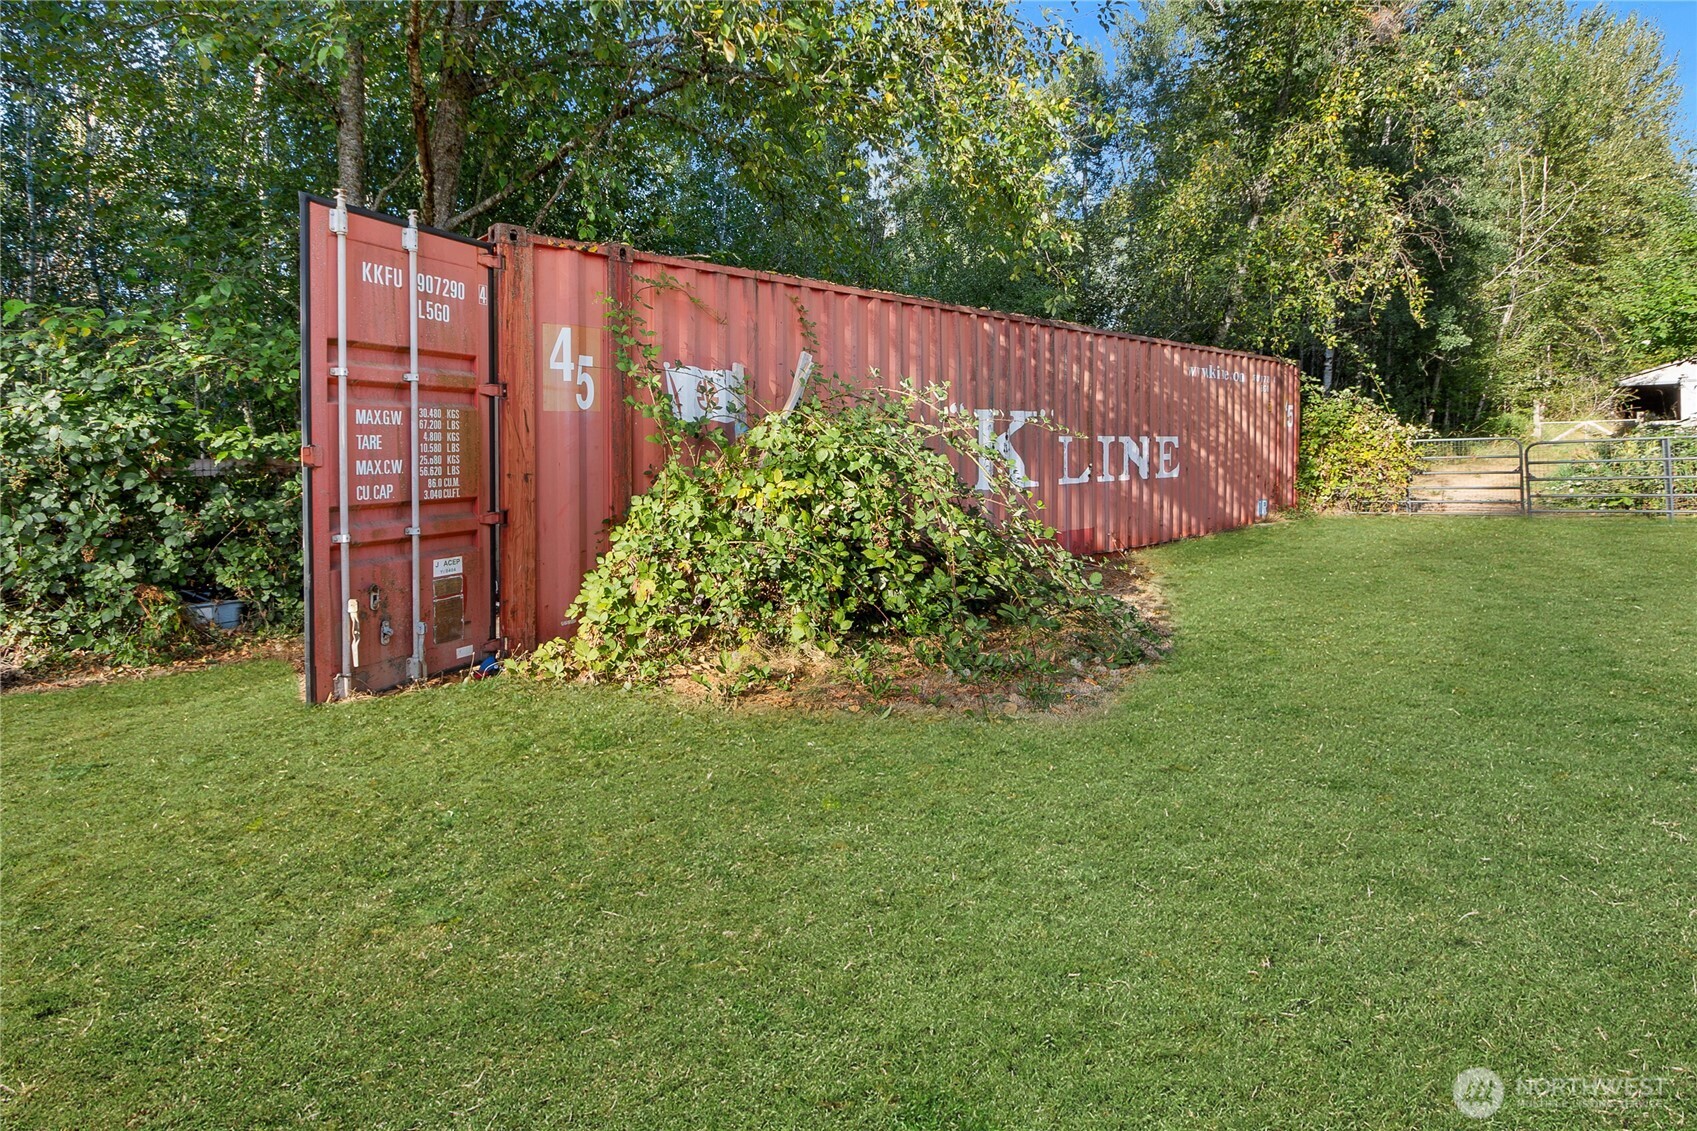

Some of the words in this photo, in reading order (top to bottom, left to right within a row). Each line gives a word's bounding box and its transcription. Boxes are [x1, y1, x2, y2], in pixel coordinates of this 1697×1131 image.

[362, 261, 403, 288] KKFU
[417, 272, 465, 300] 907290
[479, 285, 487, 304] 4
[418, 408, 442, 419] 30.480
[446, 409, 460, 419] KGS
[418, 419, 442, 430] 67.200
[446, 420, 460, 430] LBS
[355, 434, 383, 450] TARE
[423, 432, 442, 442] 4.800
[446, 432, 460, 442] KGS
[419, 443, 442, 453] 10.580
[446, 443, 460, 453] LBS
[446, 455, 460, 464] KGS
[1058, 435, 1180, 485] LINE
[419, 466, 442, 476] 56.620
[446, 465, 460, 475] LBS
